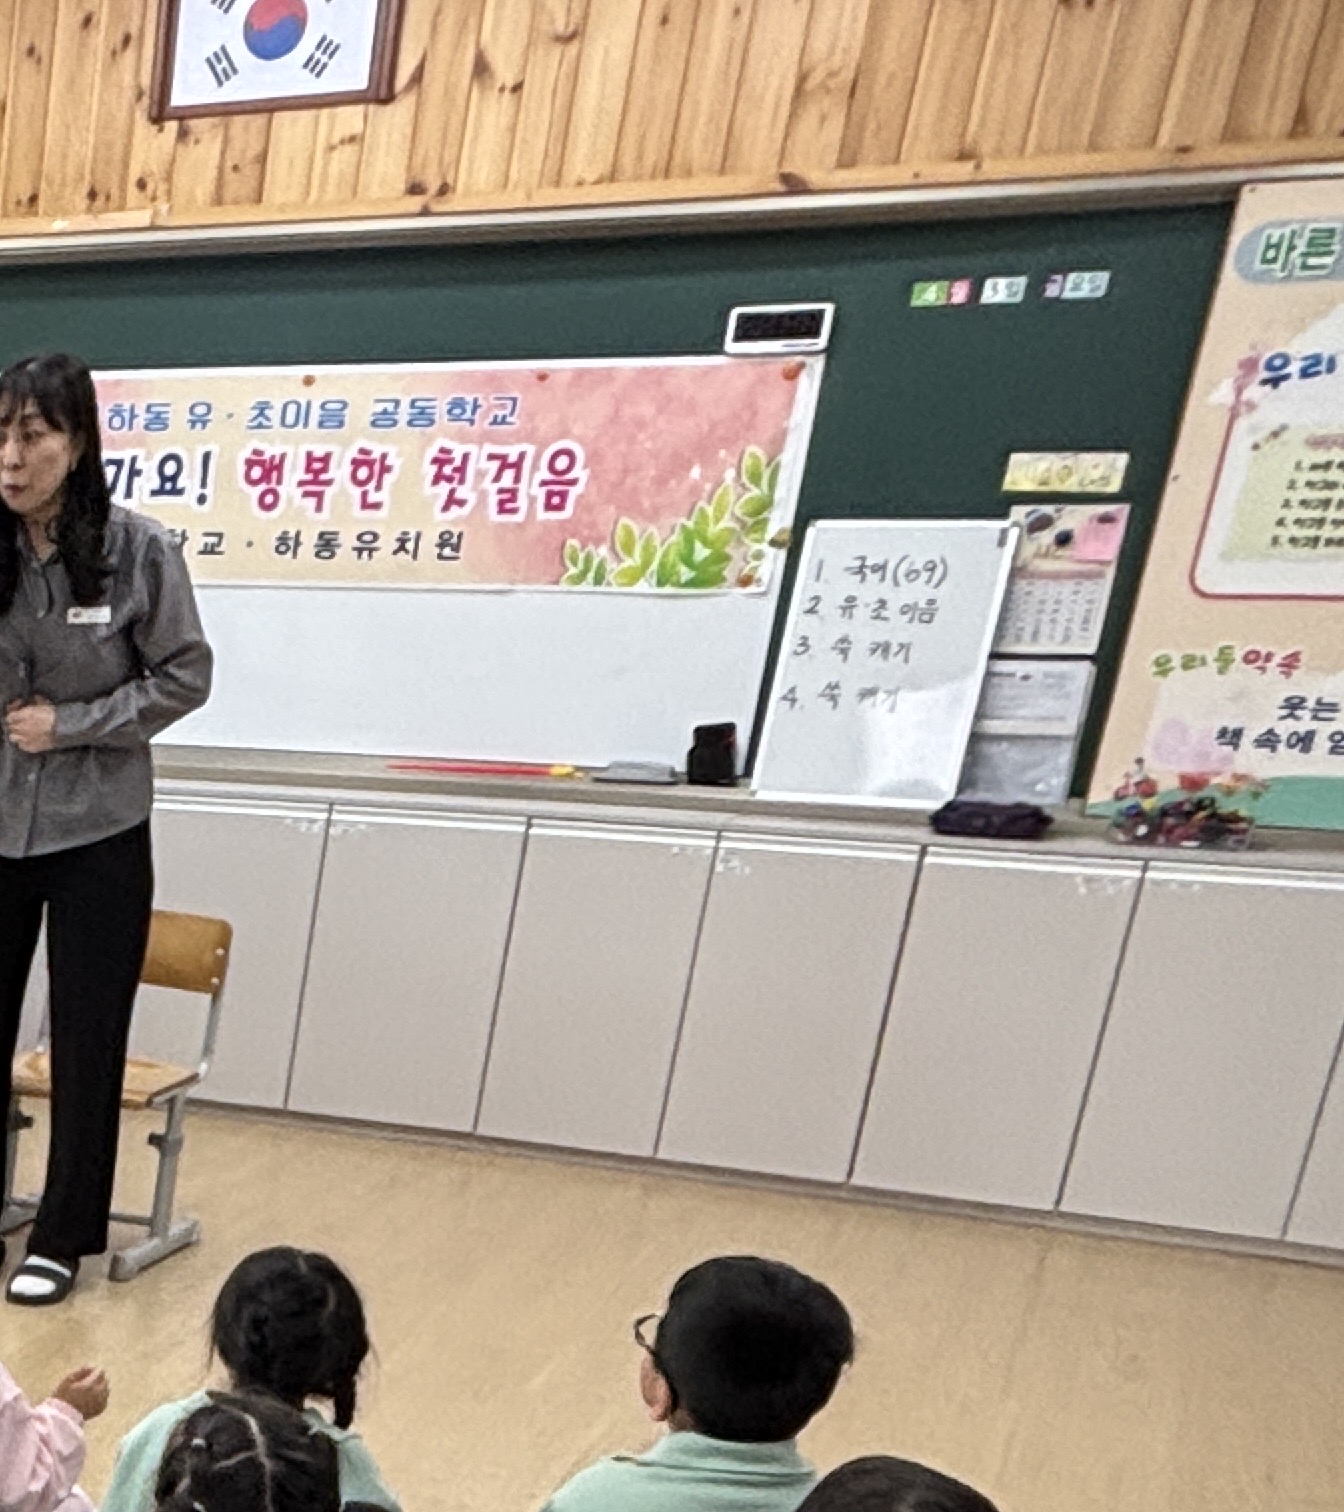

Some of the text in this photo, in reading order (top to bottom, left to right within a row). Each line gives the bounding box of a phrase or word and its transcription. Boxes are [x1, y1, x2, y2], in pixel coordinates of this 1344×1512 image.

[1260, 226, 1336, 274] 바른
[1258, 352, 1337, 390] 우리
[108, 402, 170, 433] 하동
[368, 396, 519, 430] 공동학교
[243, 447, 394, 513] 행복한
[429, 446, 580, 515] 첫걸음
[1277, 694, 1340, 722] 웃는
[1215, 724, 1245, 752] 책
[1252, 727, 1316, 754] 속에
